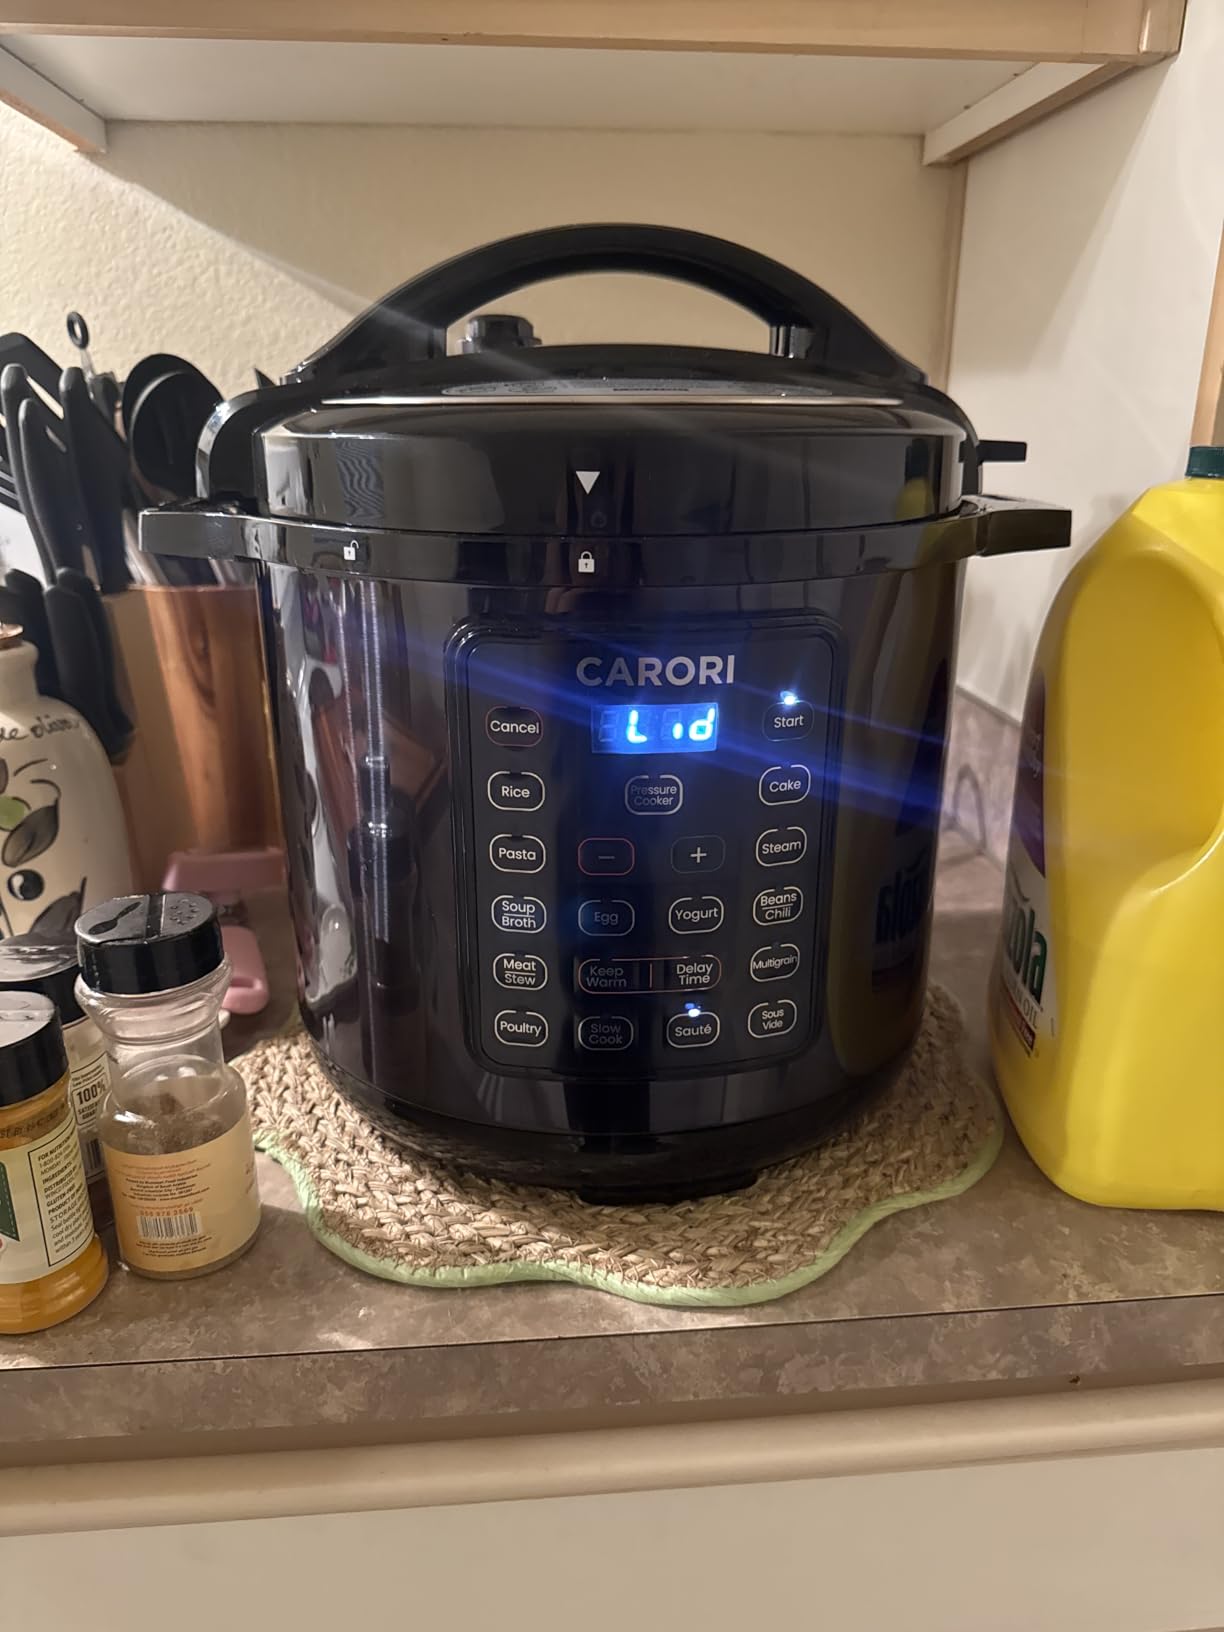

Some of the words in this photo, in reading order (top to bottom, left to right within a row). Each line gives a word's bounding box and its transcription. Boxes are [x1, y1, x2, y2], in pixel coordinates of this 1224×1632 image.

[576, 655, 735, 687] CARORI
[490, 720, 540, 735] Cancel
[625, 707, 716, 743] Lid
[774, 714, 804, 728] Start
[501, 785, 530, 799] Rice
[630, 784, 677, 797] Pressure
[768, 778, 802, 793] Cake
[633, 795, 674, 807] Cooker
[498, 847, 537, 862] Pasta
[761, 840, 802, 855] Steam
[759, 891, 798, 907] Beans
[501, 901, 536, 917] Soup
[675, 906, 719, 922] Yogurt
[764, 905, 792, 920] Chili
[501, 914, 537, 929] Broth
[594, 911, 619, 926] Egg
[503, 959, 537, 972] Meat
[752, 953, 798, 970] Multigrain
[589, 965, 624, 981] Keep
[676, 962, 714, 979] Delay
[504, 973, 536, 986] Stew
[586, 976, 627, 988] Warm
[678, 972, 711, 985] Time
[761, 1007, 785, 1020] Sous
[500, 1021, 542, 1037] Poultry
[590, 1023, 622, 1036] Slow
[675, 1022, 712, 1037] Sauté
[761, 1017, 784, 1031] Vide
[589, 1033, 623, 1046] Cook
